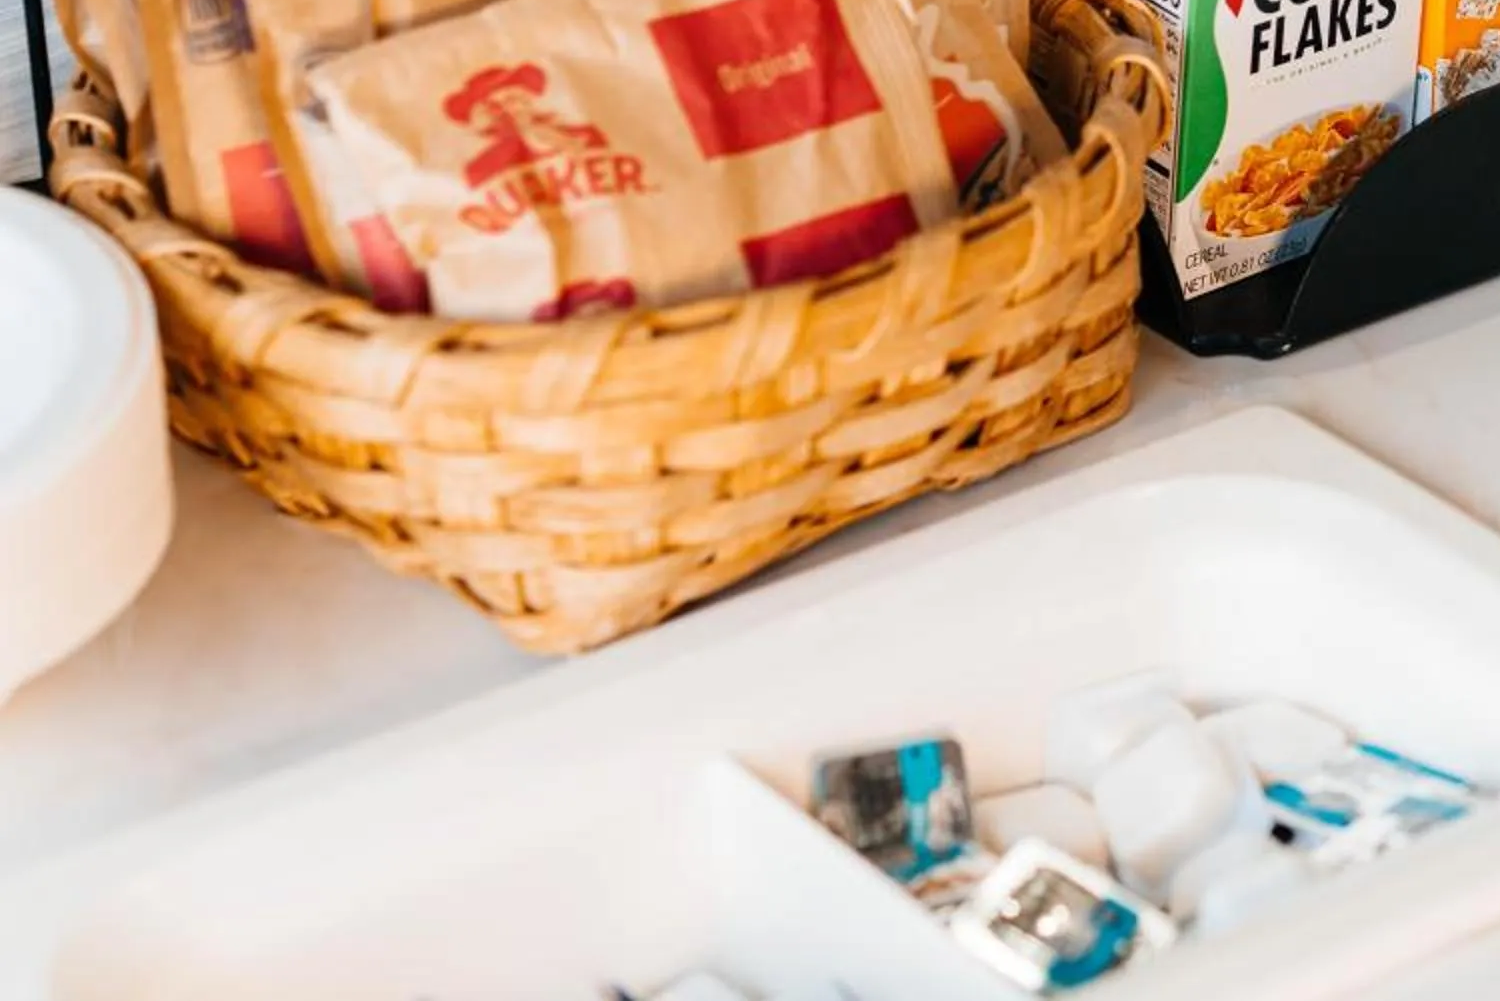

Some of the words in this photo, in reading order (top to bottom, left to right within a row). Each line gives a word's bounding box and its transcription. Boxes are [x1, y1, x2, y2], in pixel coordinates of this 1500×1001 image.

[715, 43, 813, 96] Original
[458, 152, 646, 235] QUAKER
[1185, 242, 1229, 271] CEREAL
[1183, 274, 1210, 296] NET
[1209, 267, 1230, 287] WT
